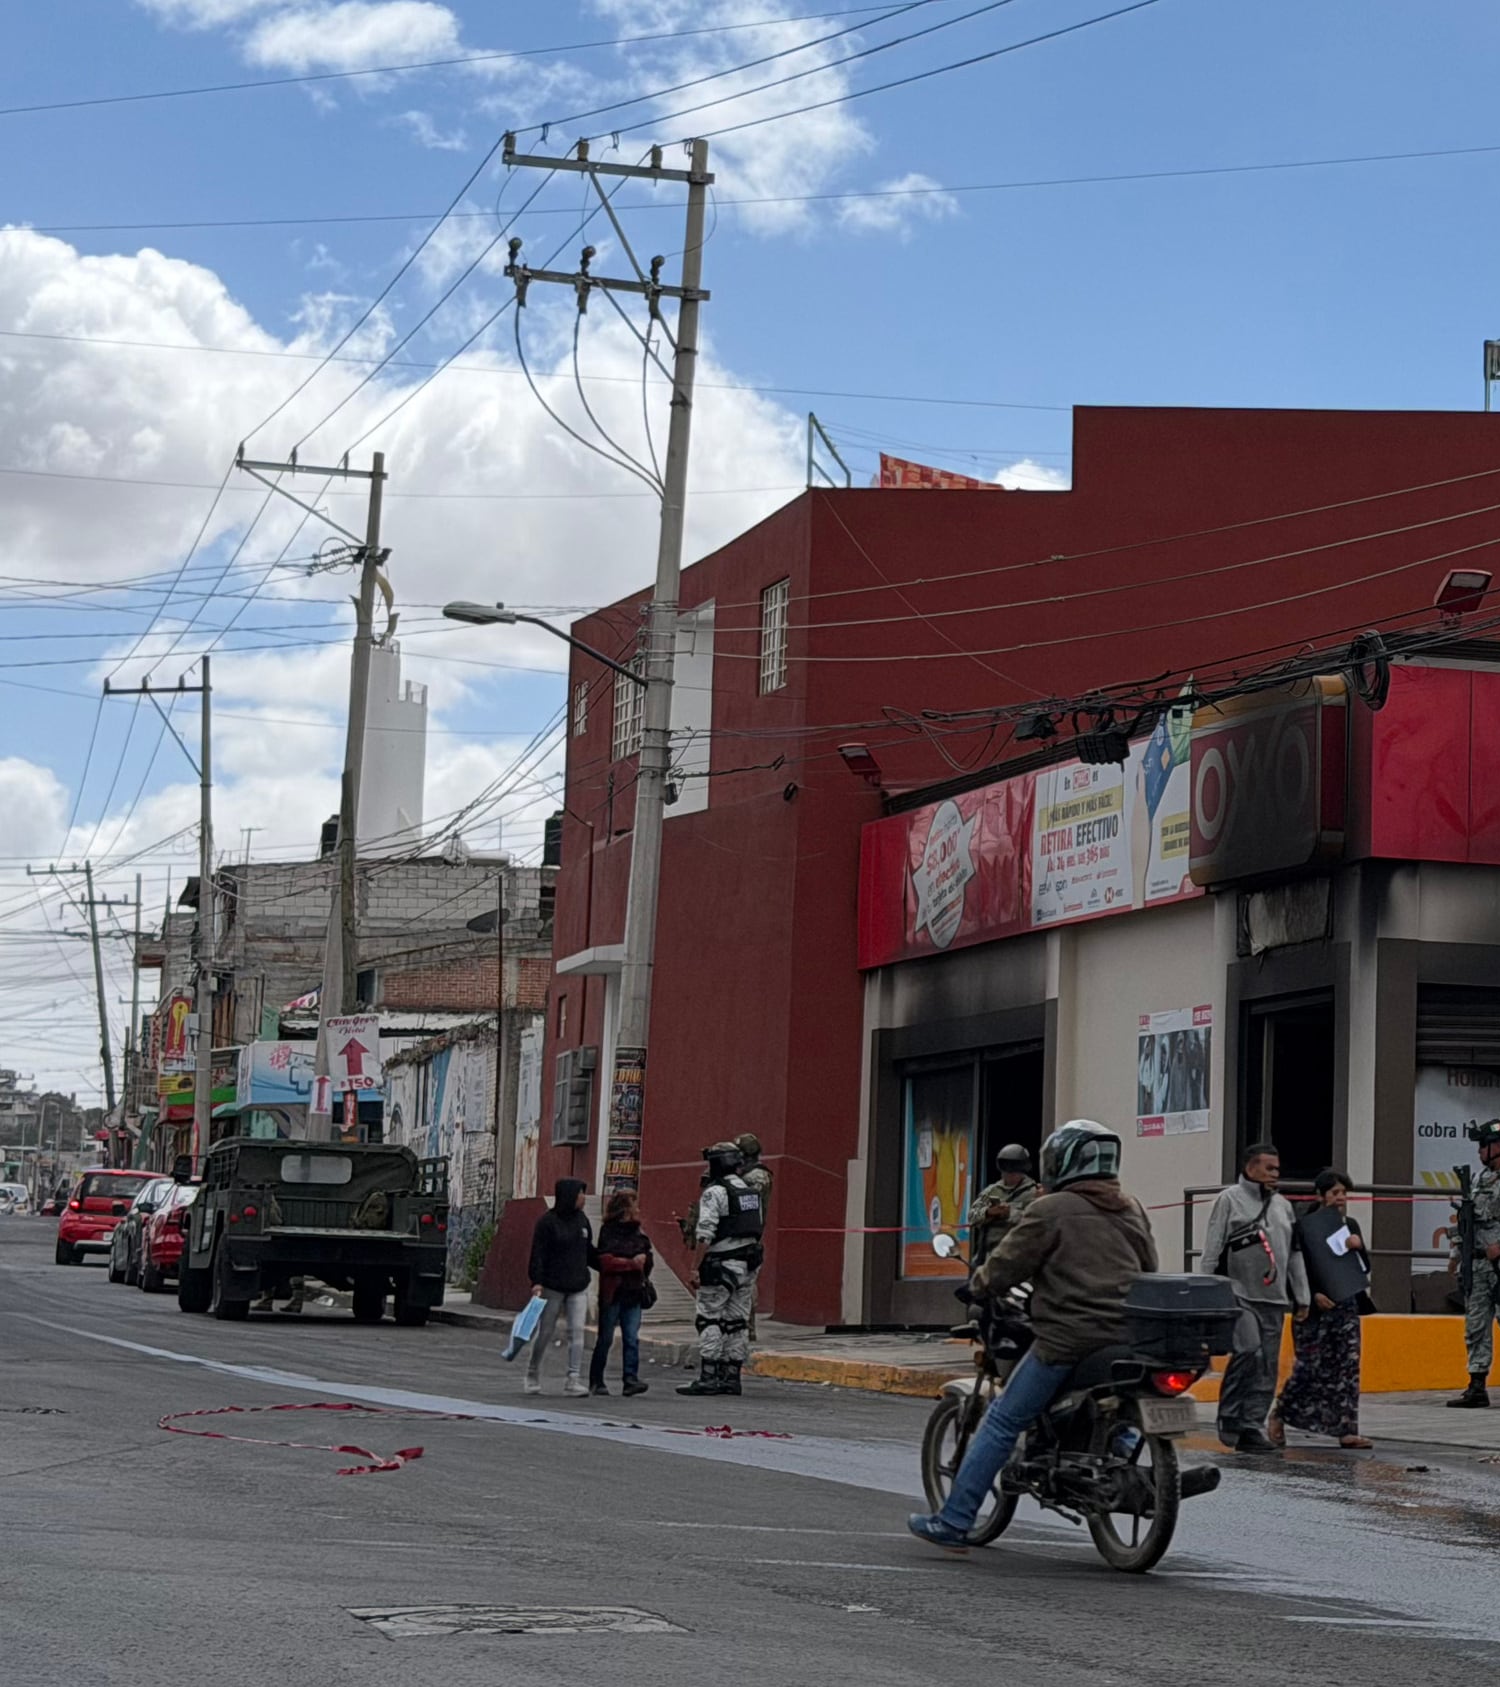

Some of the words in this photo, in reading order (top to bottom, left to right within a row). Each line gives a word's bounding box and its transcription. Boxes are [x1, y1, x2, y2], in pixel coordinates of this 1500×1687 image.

[1040, 827, 1073, 856] RETIRA
[1076, 814, 1119, 847] EFECTIVO
[1418, 1122, 1457, 1138] cobra
